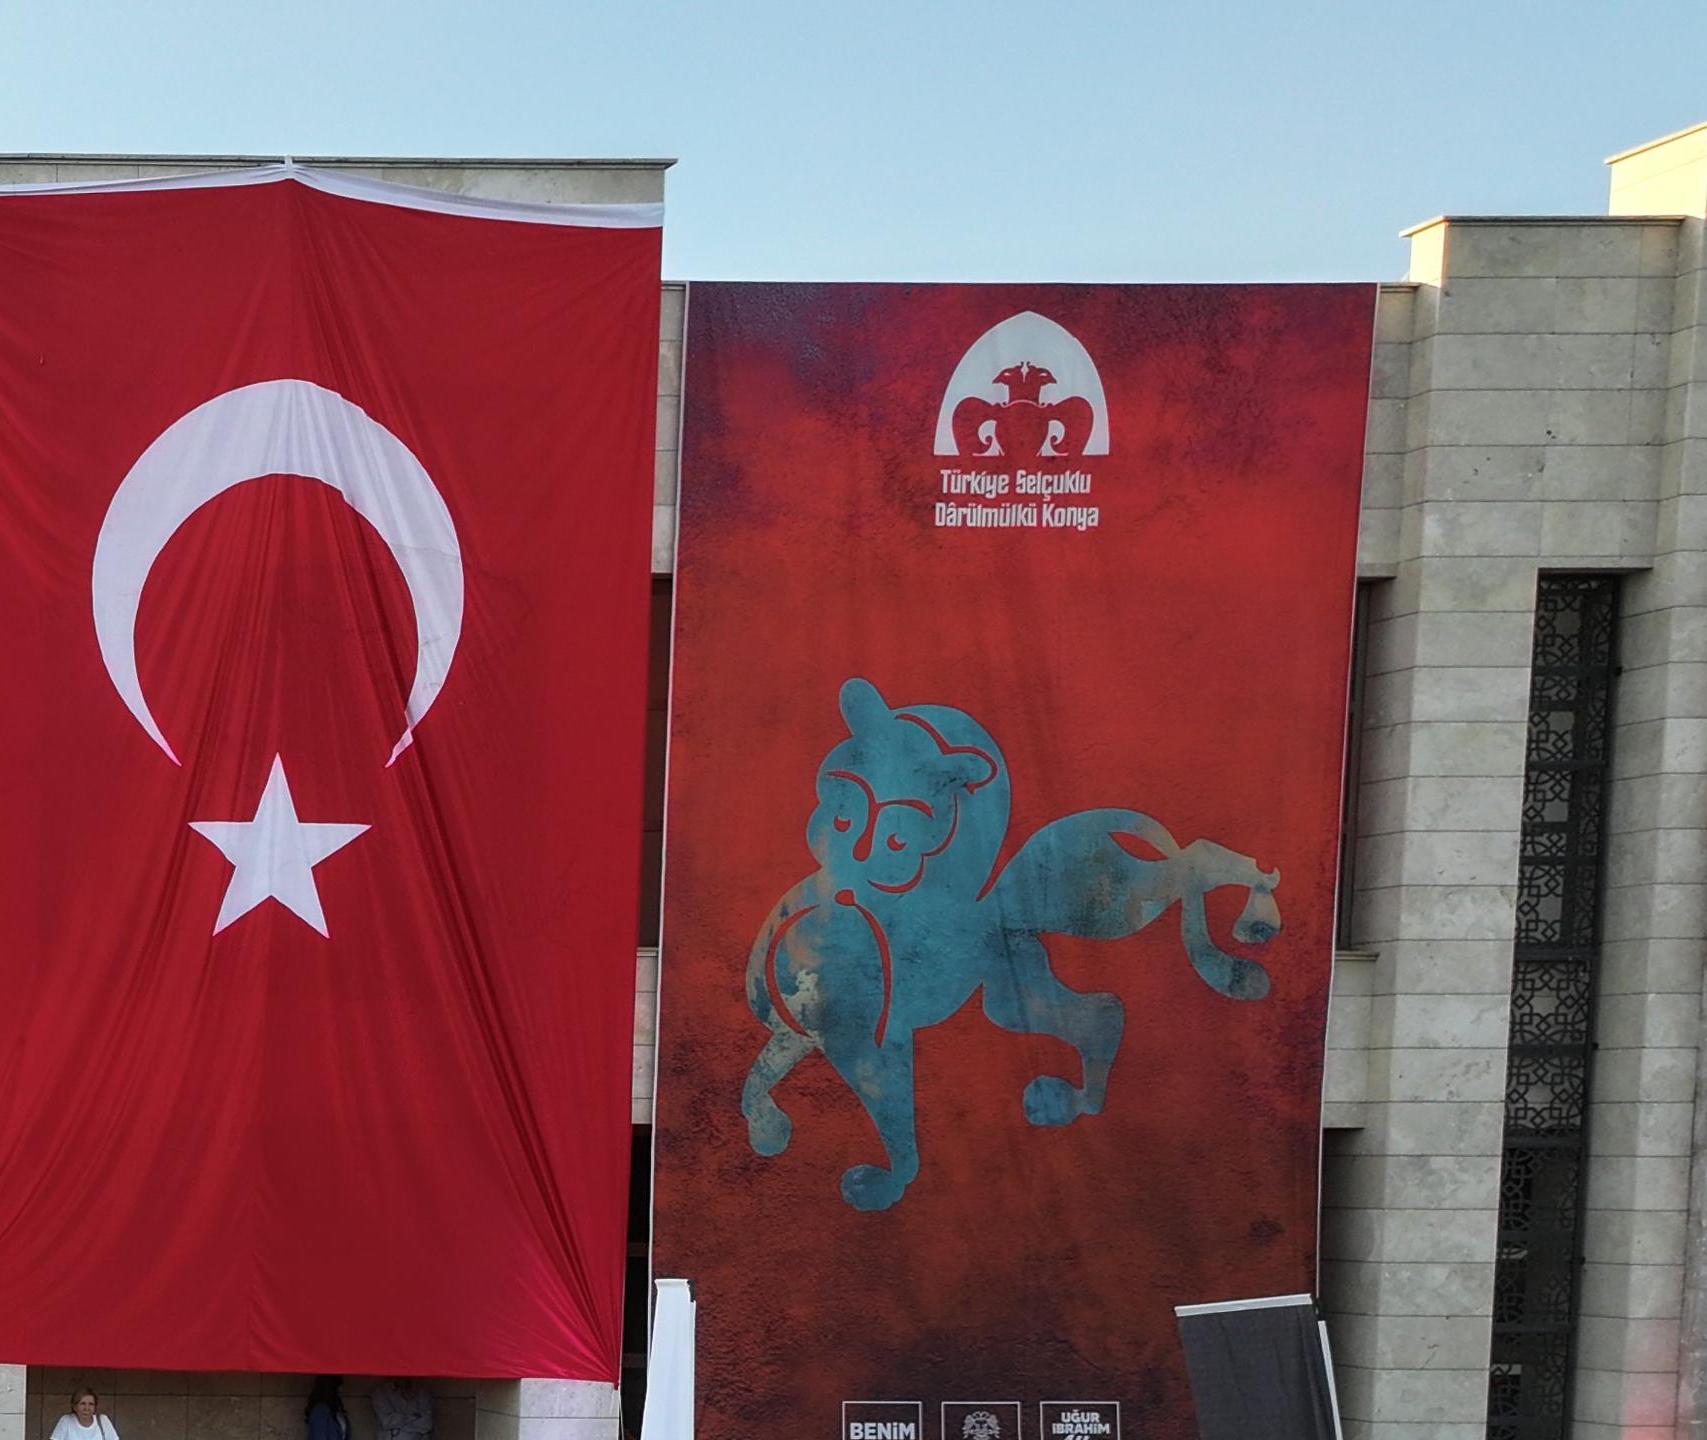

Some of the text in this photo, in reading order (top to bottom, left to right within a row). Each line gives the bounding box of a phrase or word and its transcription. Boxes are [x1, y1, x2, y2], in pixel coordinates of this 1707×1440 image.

[940, 469, 1092, 502] Türkiye Selçuklu
[934, 502, 1100, 532] Dârülmülkü Konya
[1060, 1409, 1101, 1423] UĞUR
